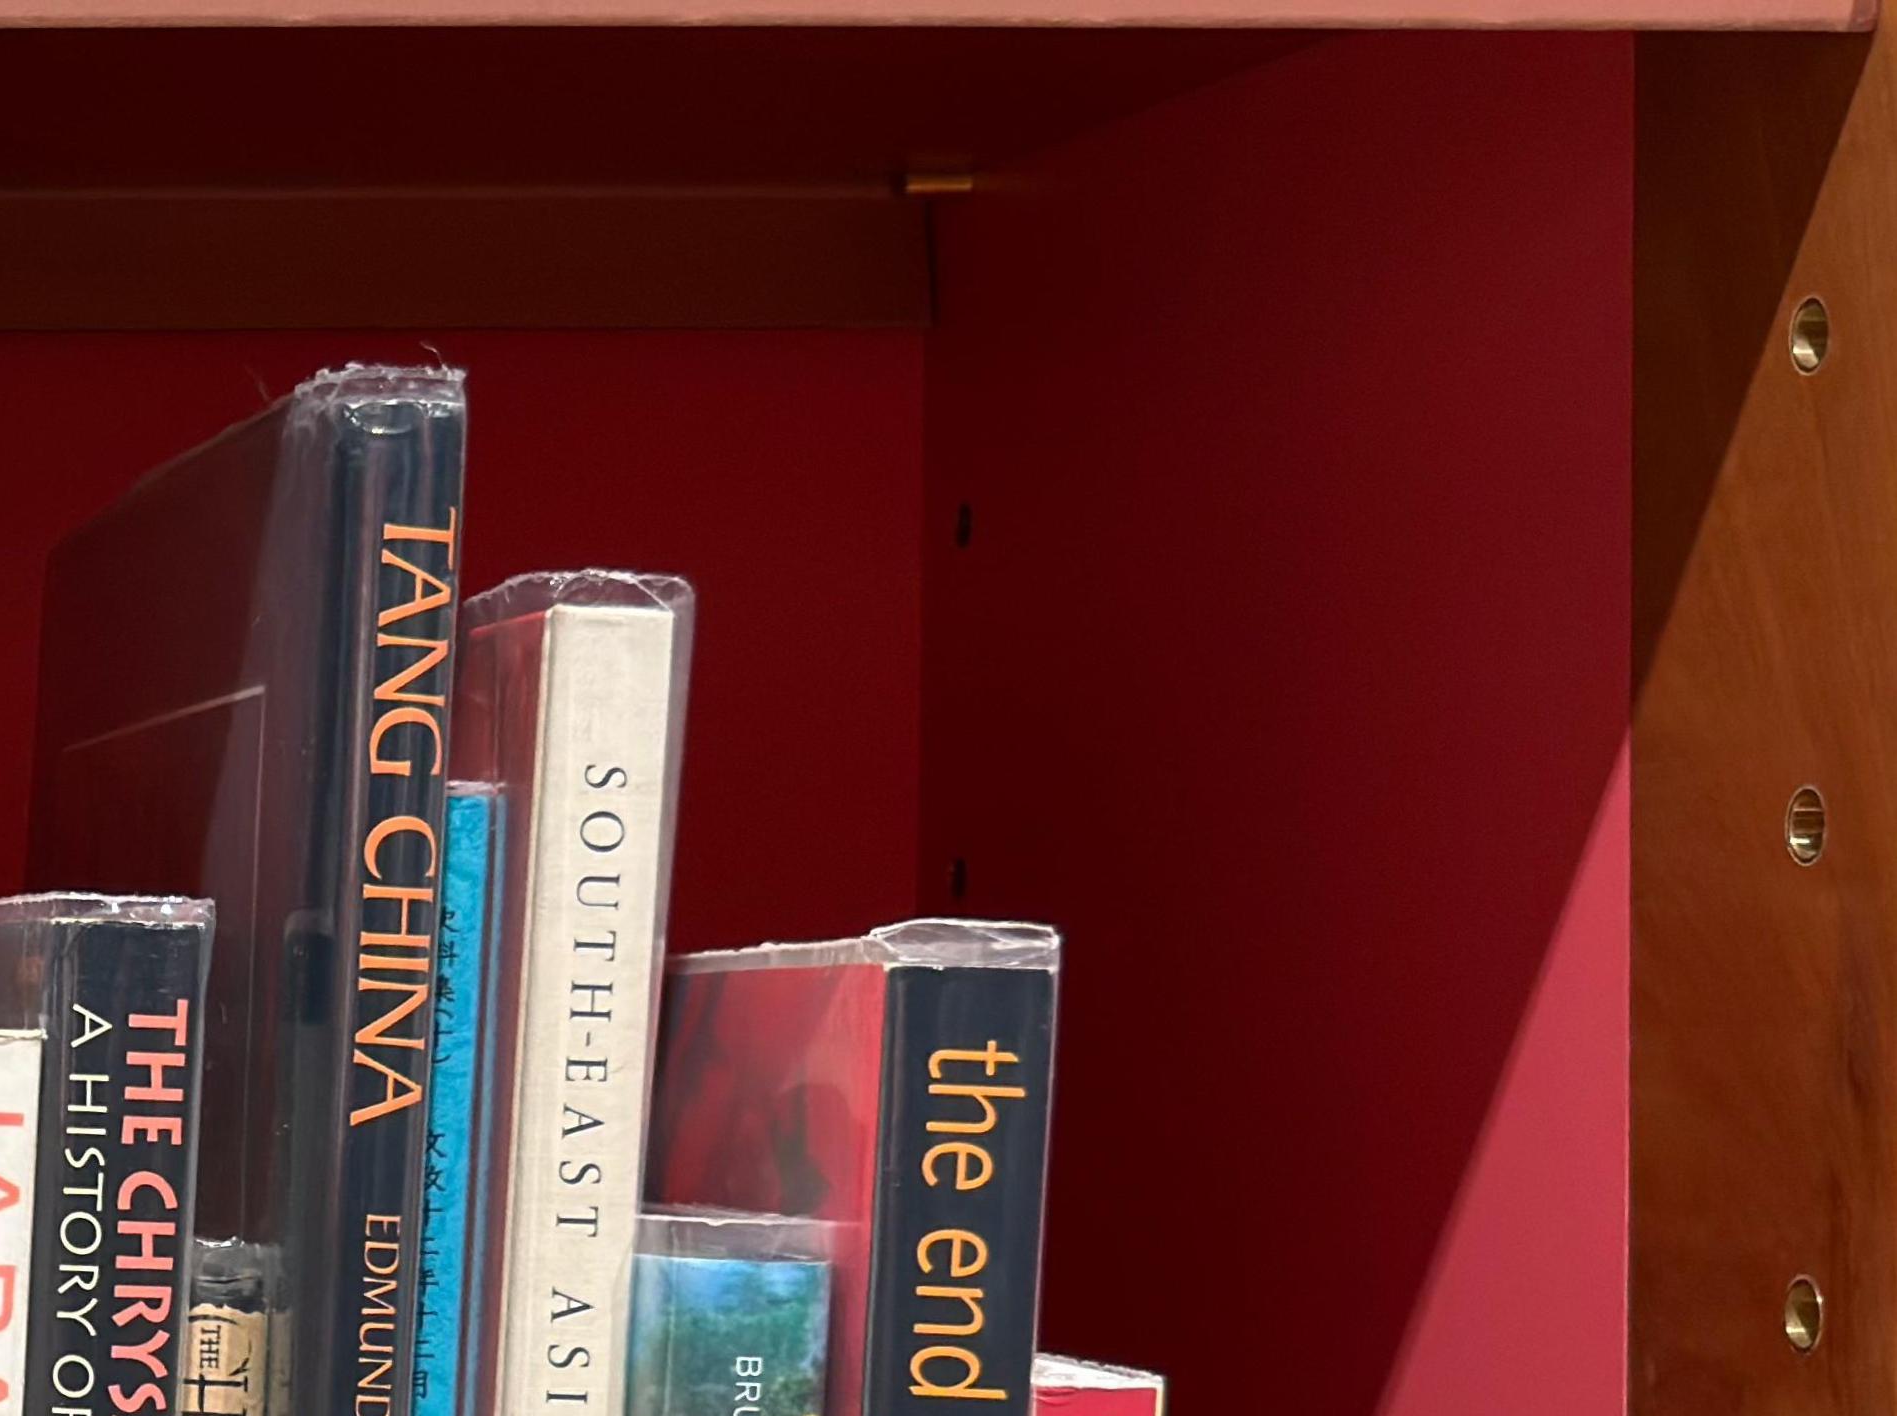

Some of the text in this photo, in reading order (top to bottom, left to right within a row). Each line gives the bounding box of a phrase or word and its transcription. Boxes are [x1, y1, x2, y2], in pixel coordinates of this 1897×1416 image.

[348, 507, 457, 1127] TANG CHINA
[70, 1003, 113, 1049] A
[121, 999, 189, 1146] THE
[555, 762, 628, 1237] SOUTH-EAST
[921, 1039, 1026, 1191] the
[53, 1073, 110, 1338] HISTORY
[908, 1229, 1008, 1399] end
